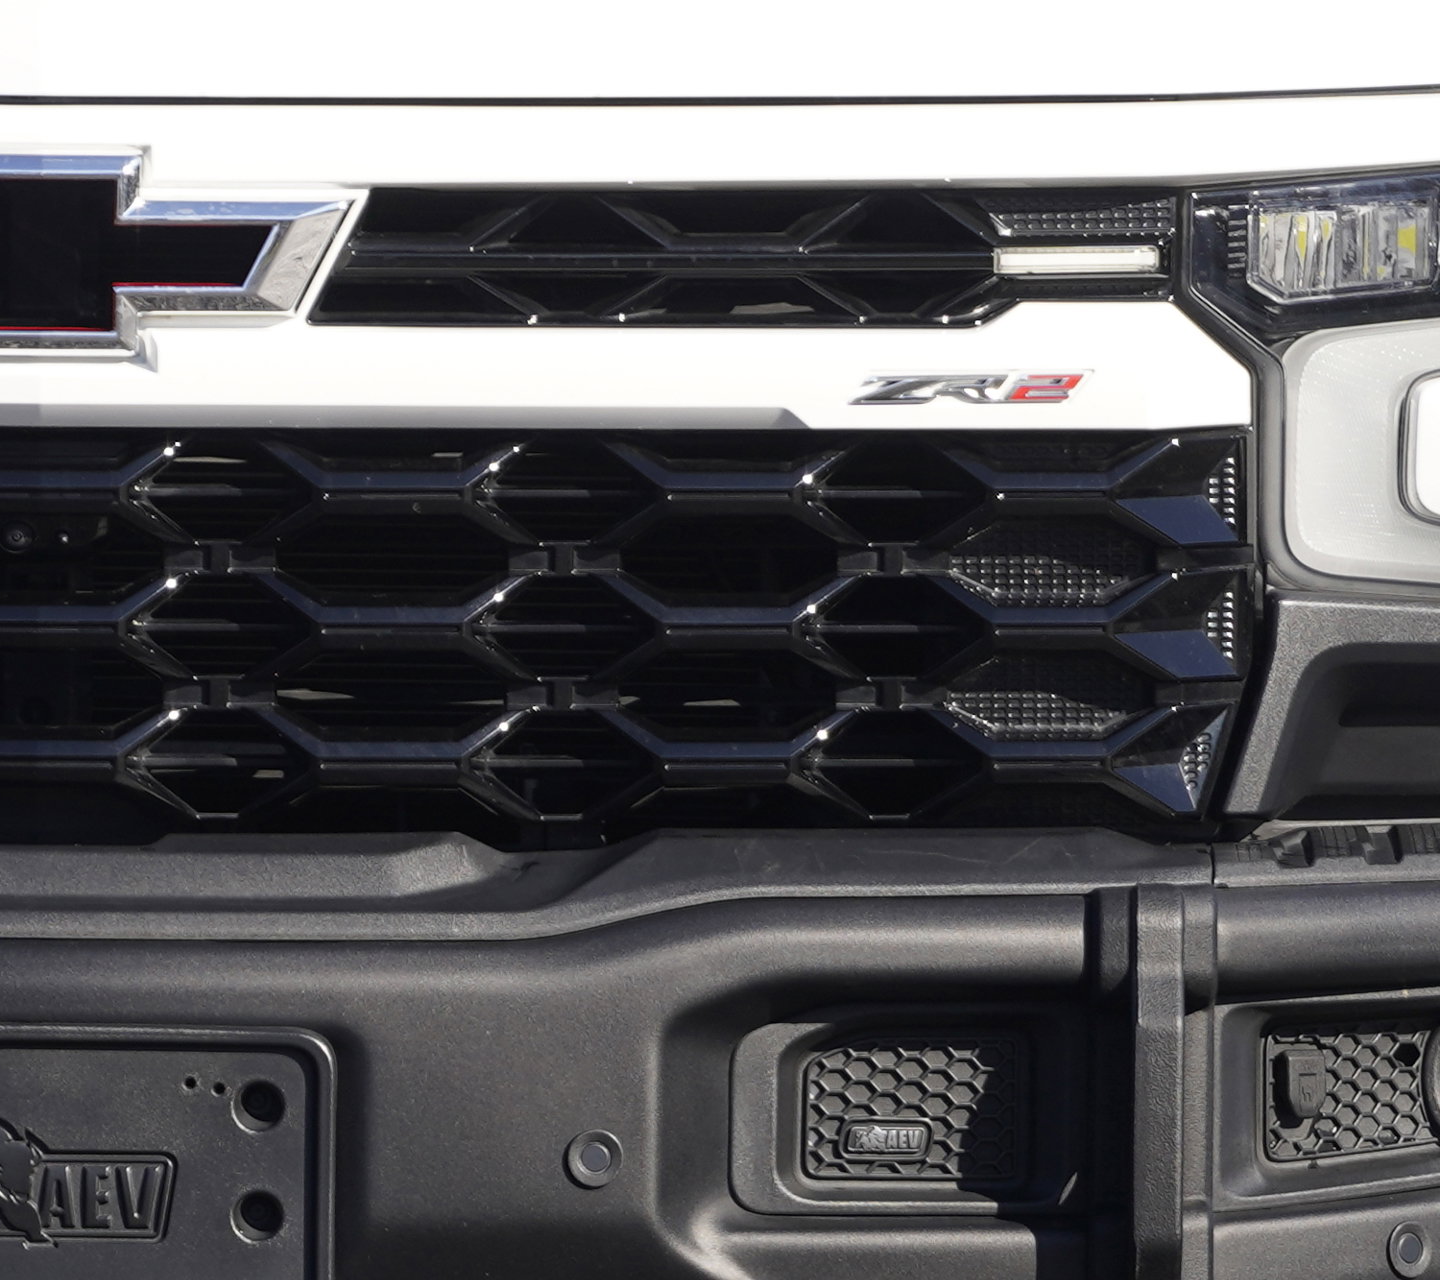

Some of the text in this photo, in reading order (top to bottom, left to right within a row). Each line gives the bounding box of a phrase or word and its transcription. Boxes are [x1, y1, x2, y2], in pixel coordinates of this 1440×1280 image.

[847, 373, 1084, 405] ZR2
[886, 1129, 921, 1149] AEV
[41, 1164, 163, 1230] AEV
